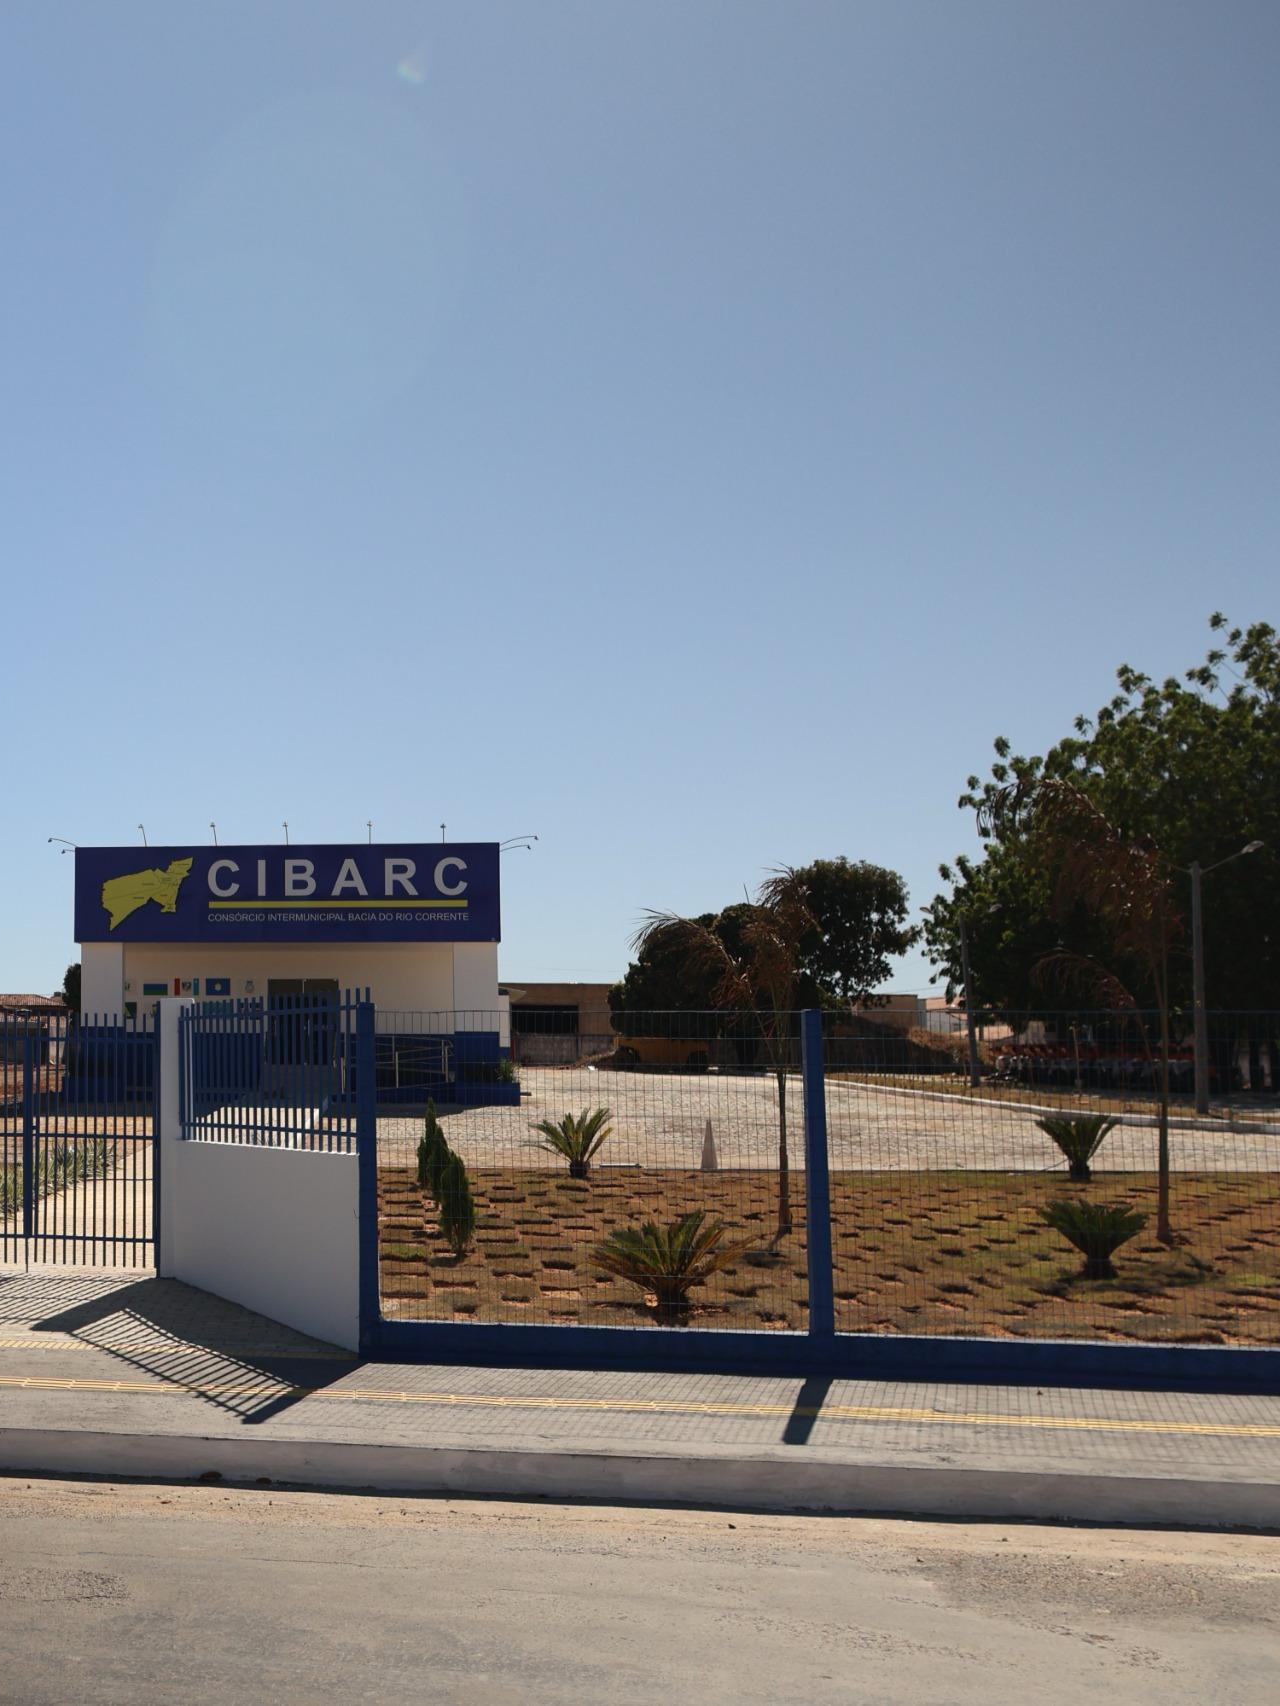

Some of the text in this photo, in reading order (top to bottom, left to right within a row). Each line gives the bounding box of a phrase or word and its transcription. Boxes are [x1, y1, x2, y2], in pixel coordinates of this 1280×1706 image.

[207, 857, 469, 897] CIBARC
[208, 911, 469, 922] CONSÓRCIO INTERMUNICIPAL BACIA DO RIO CORRENTE
